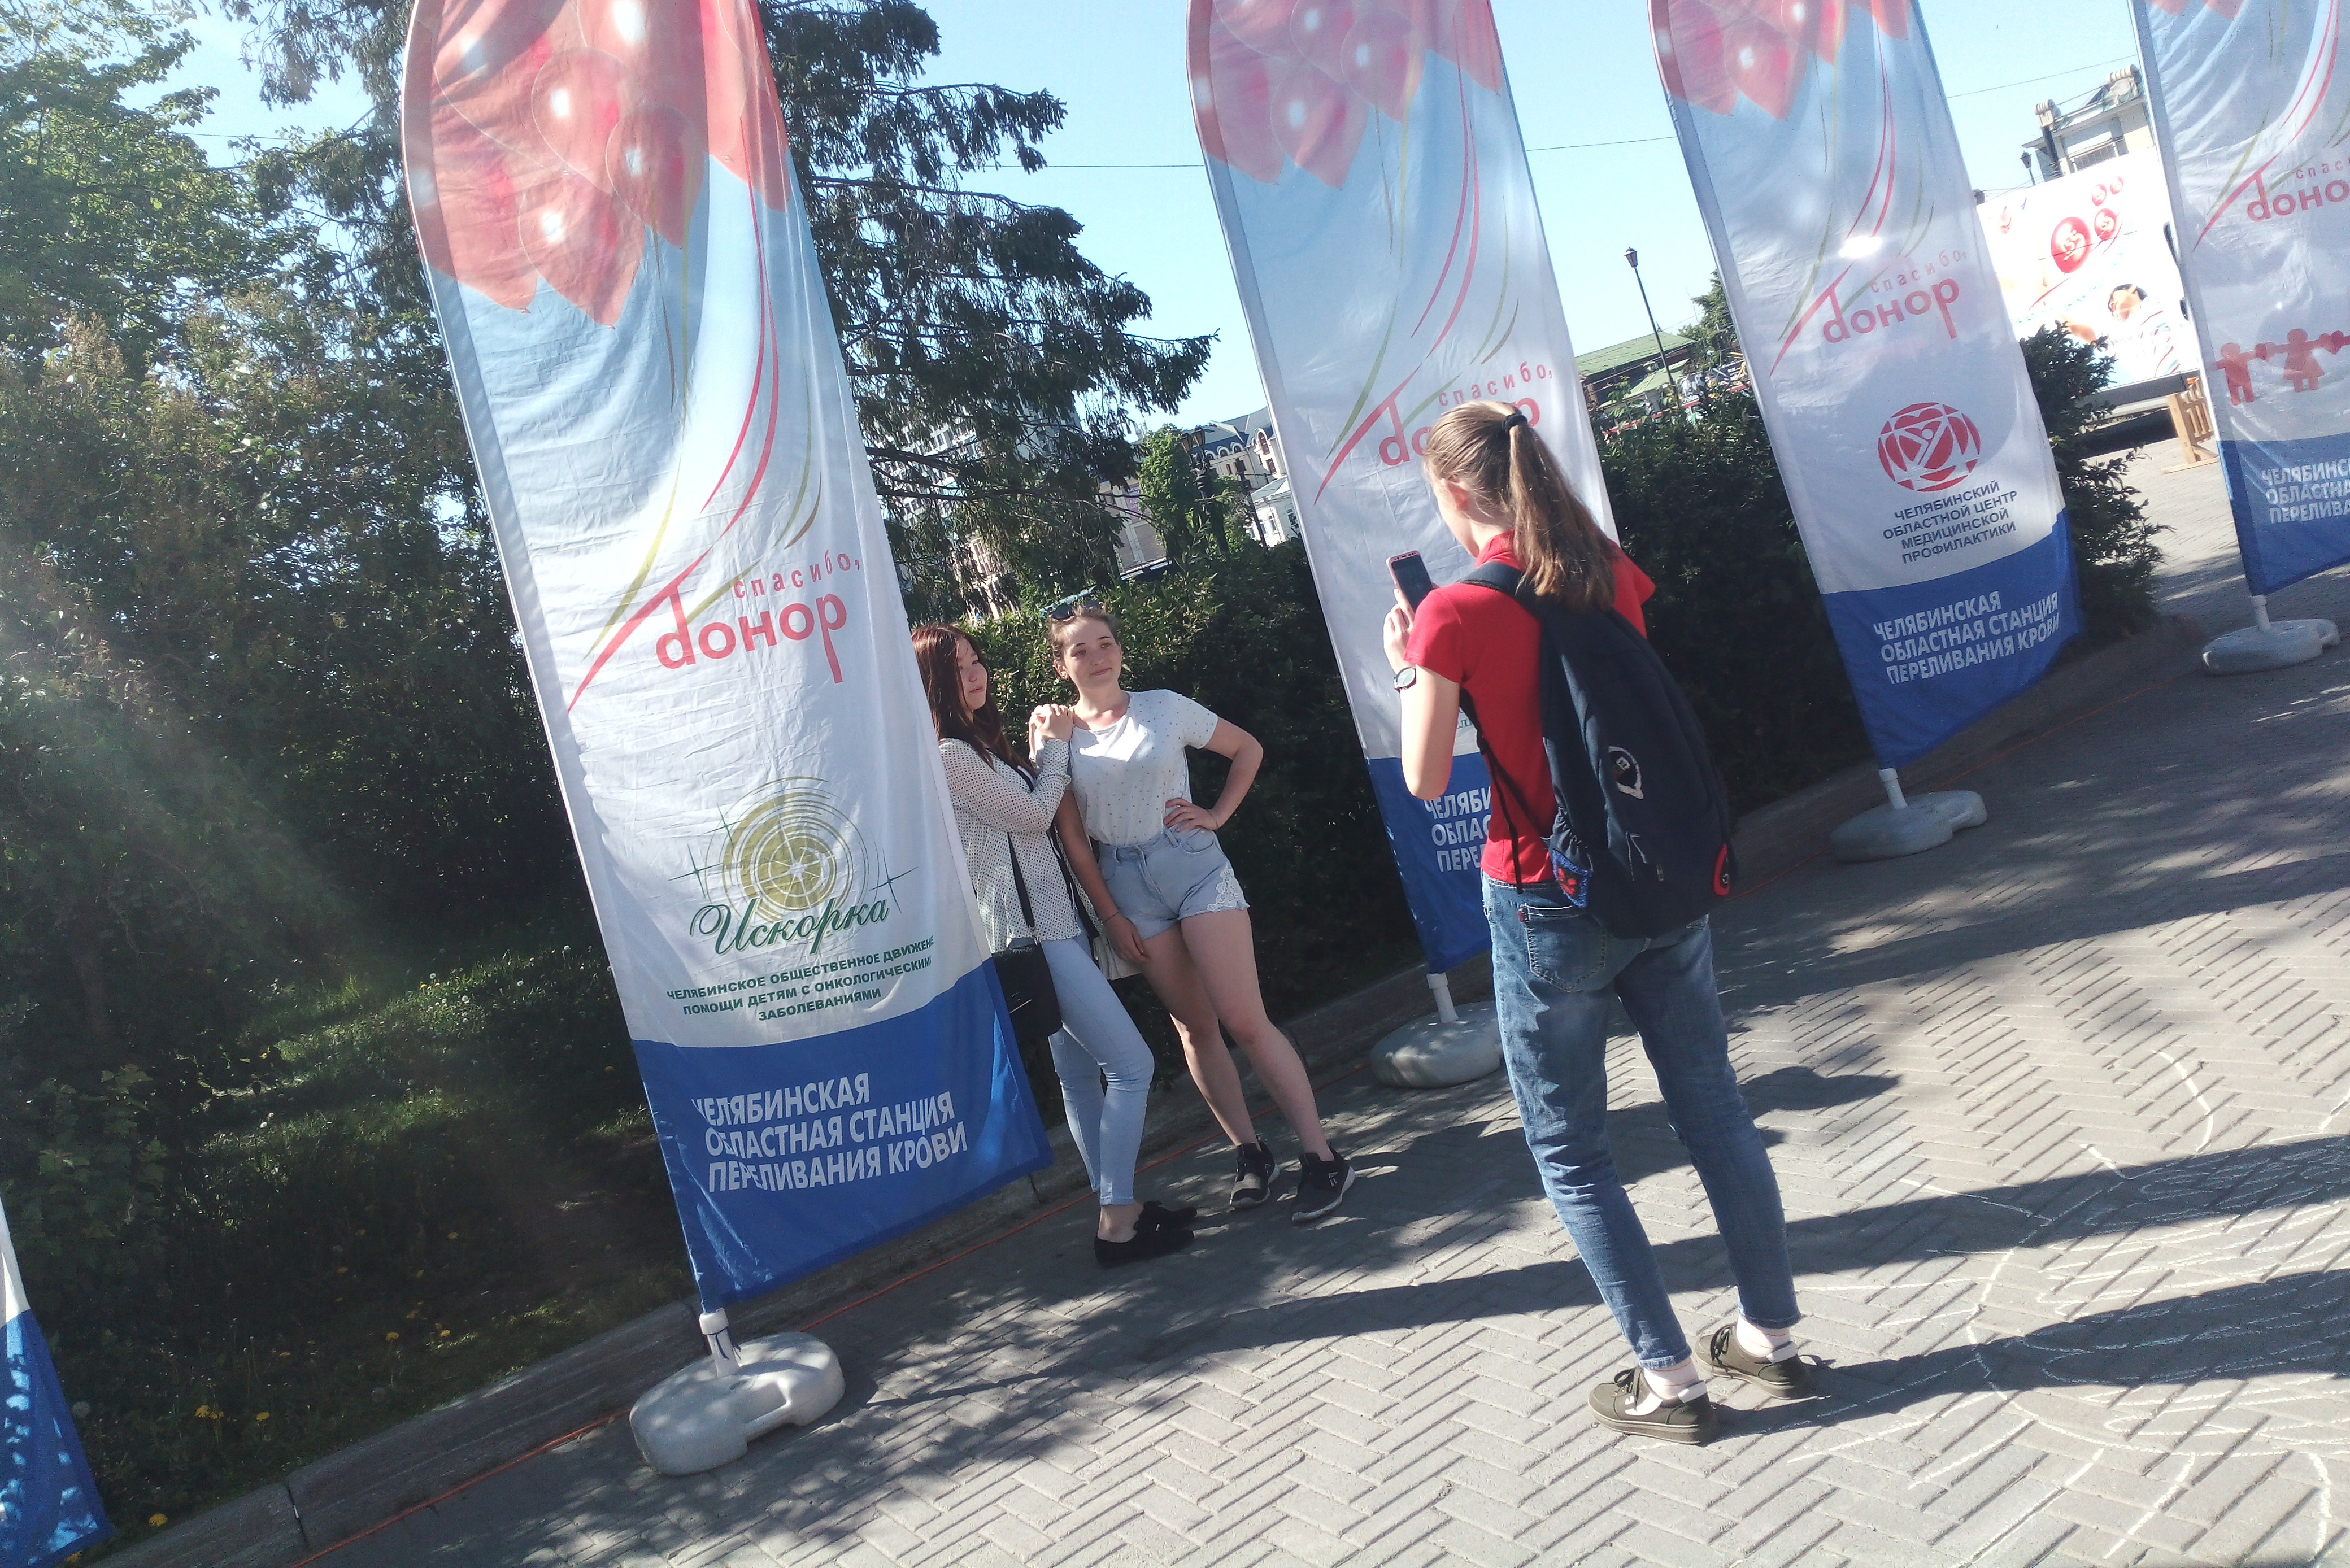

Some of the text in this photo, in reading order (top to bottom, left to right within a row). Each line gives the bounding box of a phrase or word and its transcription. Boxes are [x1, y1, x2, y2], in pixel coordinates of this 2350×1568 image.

[2295, 158, 2350, 179] спас
[1870, 249, 1966, 293] спасибо,
[1823, 278, 1960, 343] донор
[1438, 360, 1553, 407] спасибо,
[2262, 458, 2350, 486] ЧЕЛЯБИНС
[1883, 490, 2018, 539] ОБЛАСТНОЙ ЦЕНТР
[1894, 480, 2000, 521] ЧЕЛЯБИНСКИЙ
[1901, 508, 2010, 550] МЕДИЦИНСКОЙ
[1901, 521, 2017, 564] ПРОФИЛАКТИКИ
[734, 550, 861, 599] спасибо,
[655, 586, 847, 684] донор
[1873, 590, 2002, 641] ЧЕЛЯБИНСКАЯ
[1881, 591, 2058, 663] ОБЛАСТНАЯ СТАНЦИЯ
[1886, 612, 2059, 685] ПЕРЕЛИВАНИЯ КРОВИ
[689, 897, 890, 955] Искорка
[667, 975, 767, 1000] ЧЕЛЯБИНСКОЕ
[769, 953, 880, 983] ОБЩЕСТВЕННОЕ
[683, 998, 744, 1015] ПОМОЩИ
[747, 987, 798, 1008] ДЕТЯМ
[802, 985, 811, 995] С
[758, 987, 882, 1021] ЗАБОЛЕВАНИЯМИ
[850, 1091, 955, 1142] СТАНЦИЯ
[888, 1121, 968, 1174] КРОВИ
